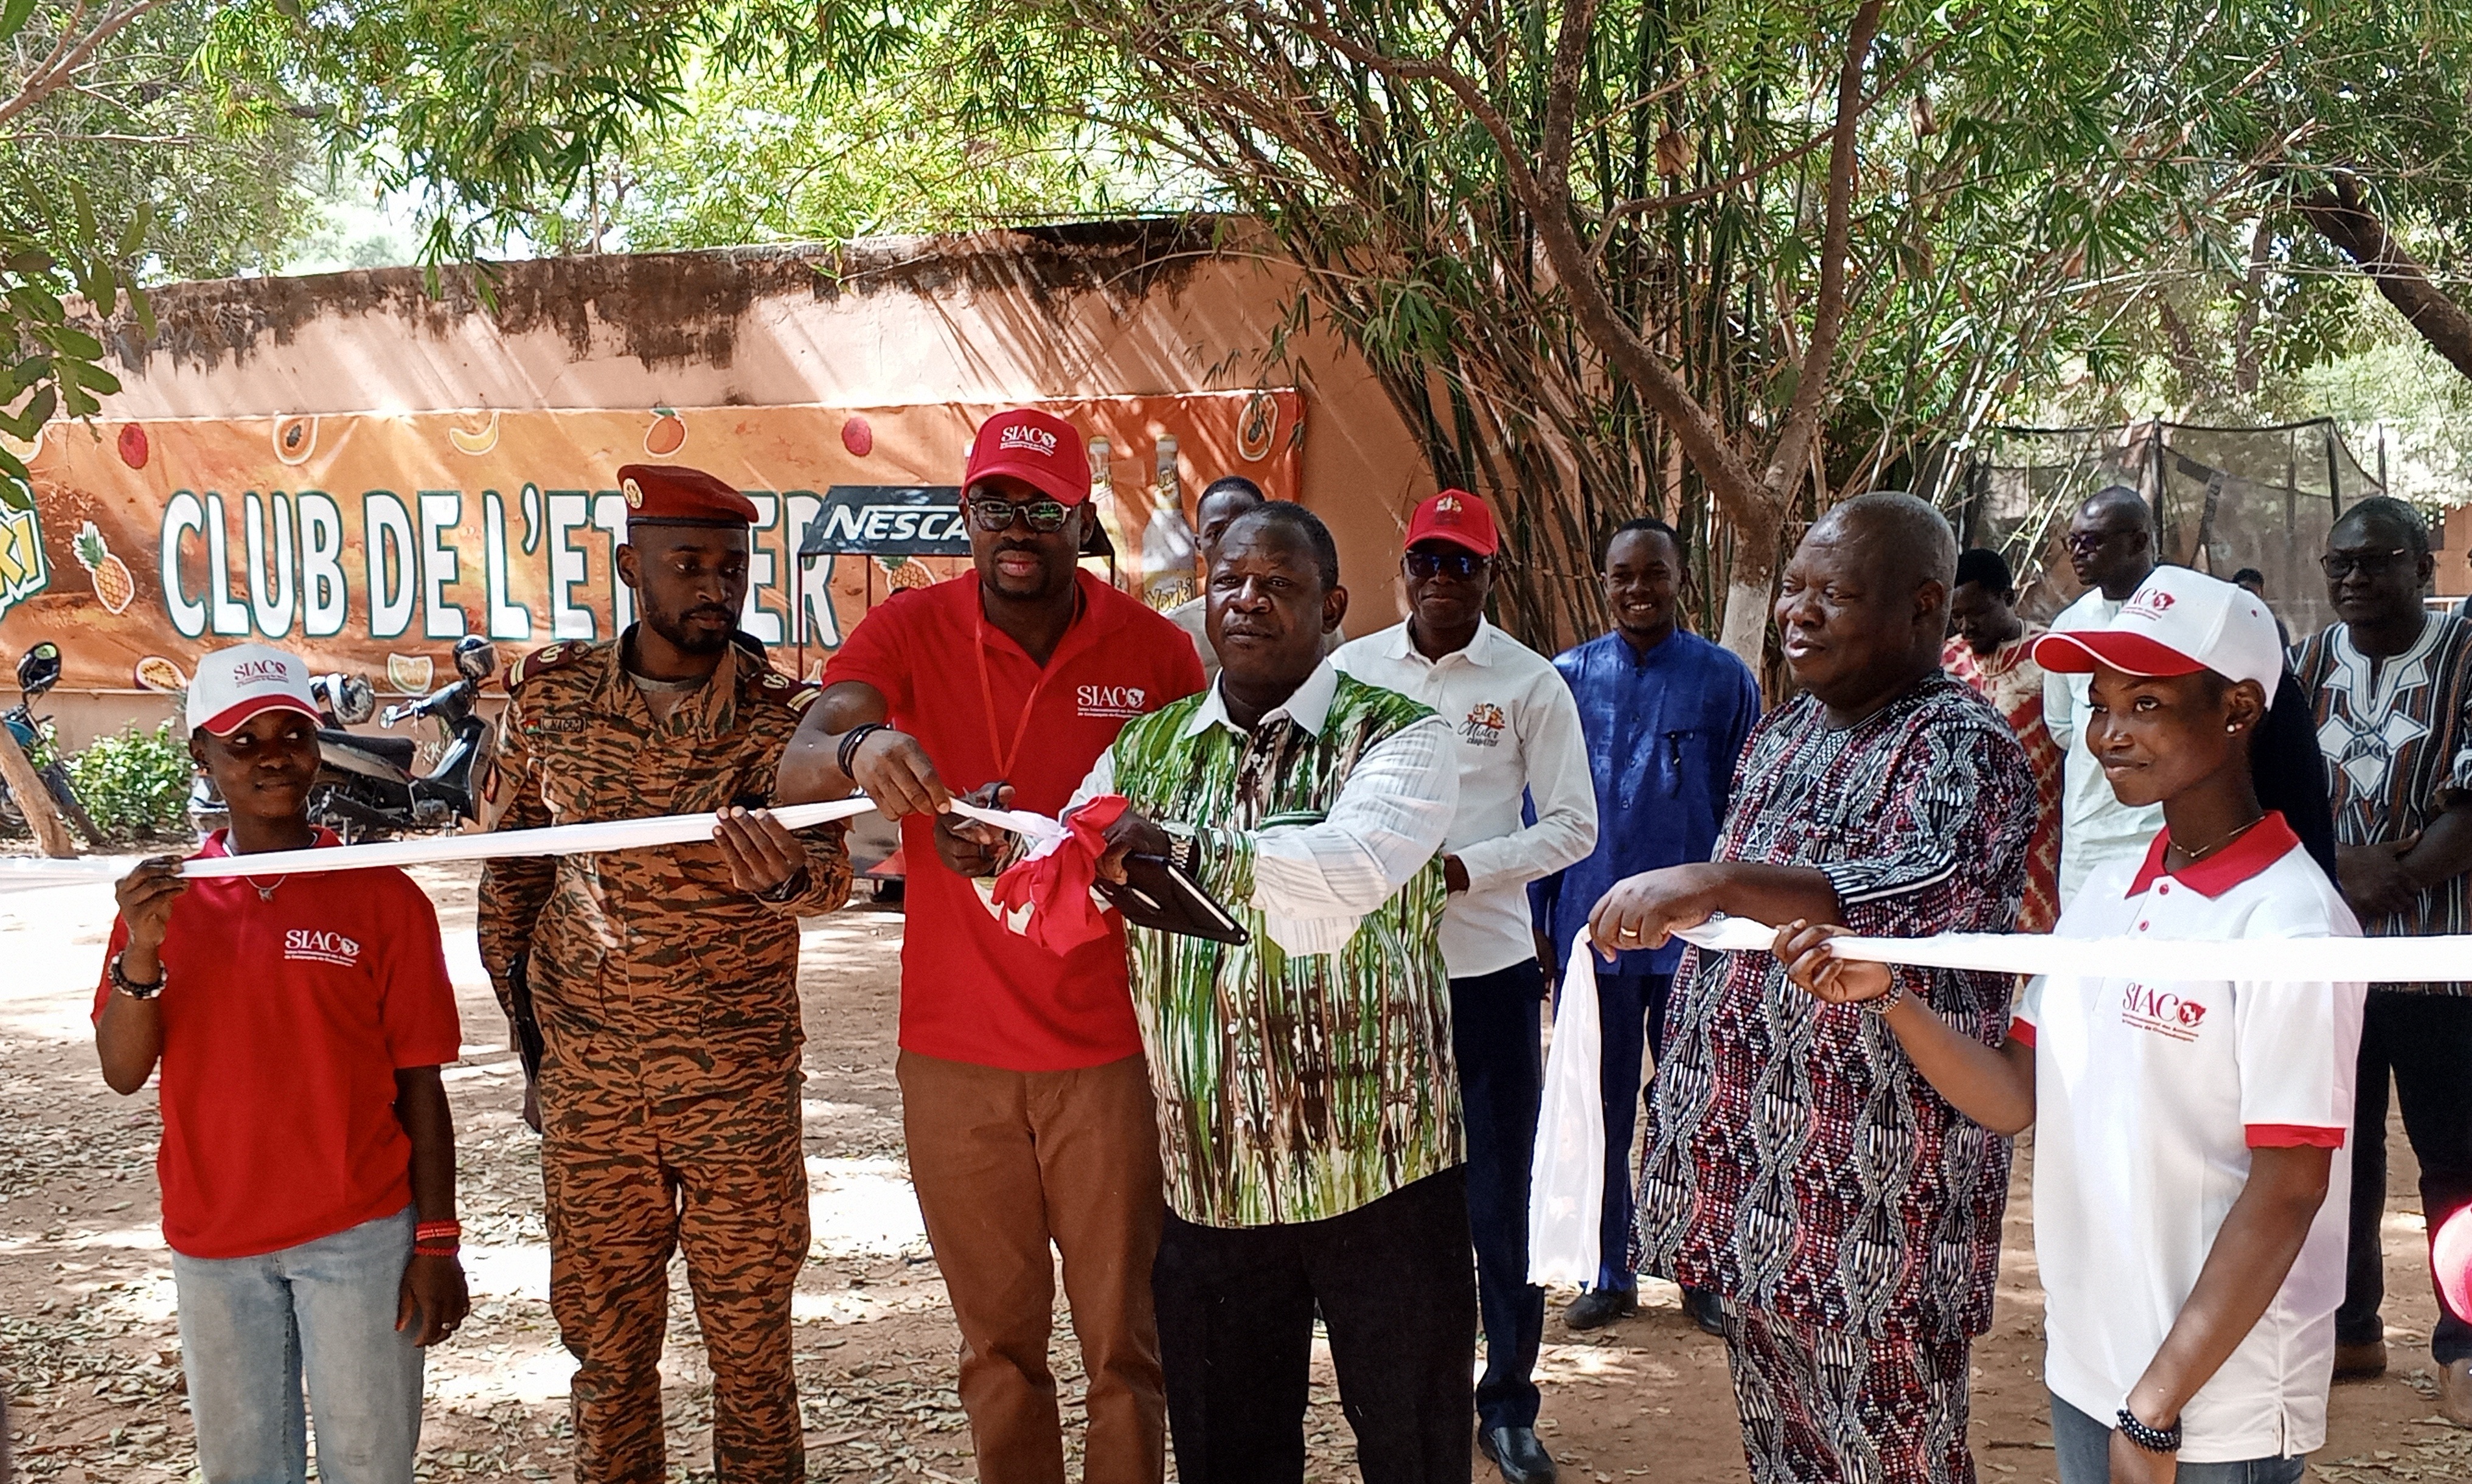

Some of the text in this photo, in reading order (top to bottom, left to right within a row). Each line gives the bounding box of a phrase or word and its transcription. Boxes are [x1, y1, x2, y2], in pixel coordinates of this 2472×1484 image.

[160, 482, 841, 650] CLUB DE L'ETER
[822, 504, 972, 540] NESCA
